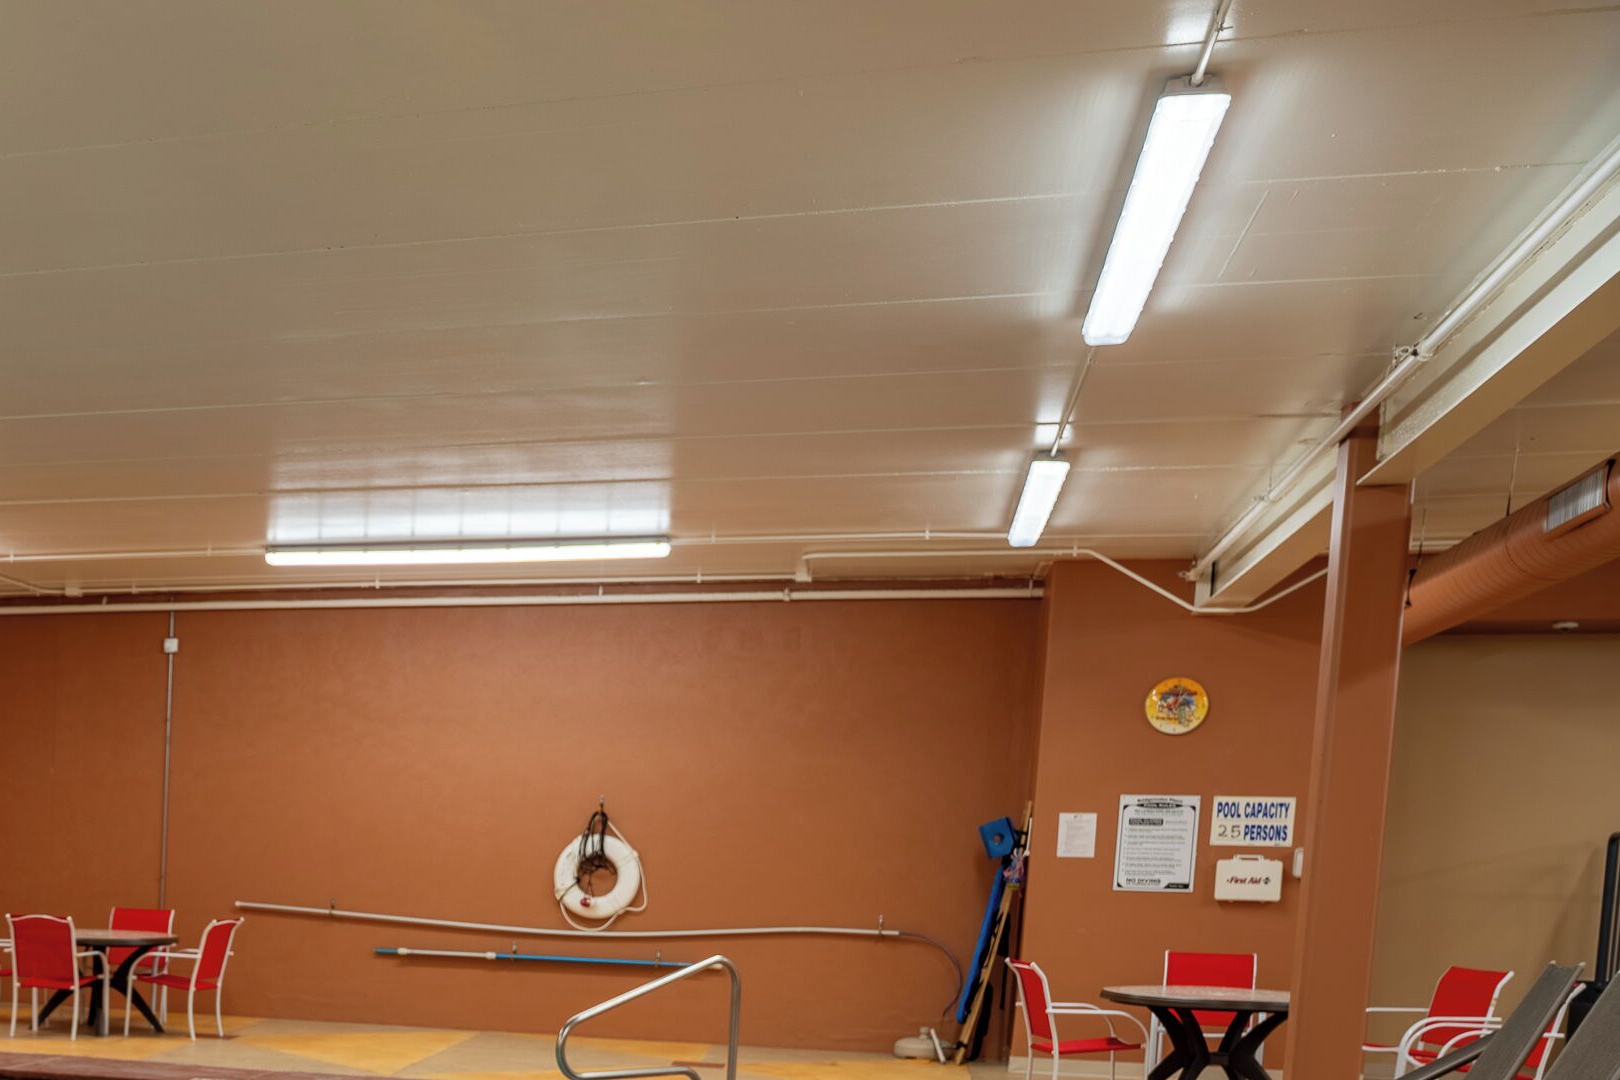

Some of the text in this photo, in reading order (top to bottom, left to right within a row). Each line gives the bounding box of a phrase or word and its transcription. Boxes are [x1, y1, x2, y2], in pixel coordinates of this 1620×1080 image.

[1217, 802, 1290, 819] POOL CAPACITY
[1218, 824, 1288, 841] 25 PERSONS
[1229, 876, 1262, 884] First Aid
